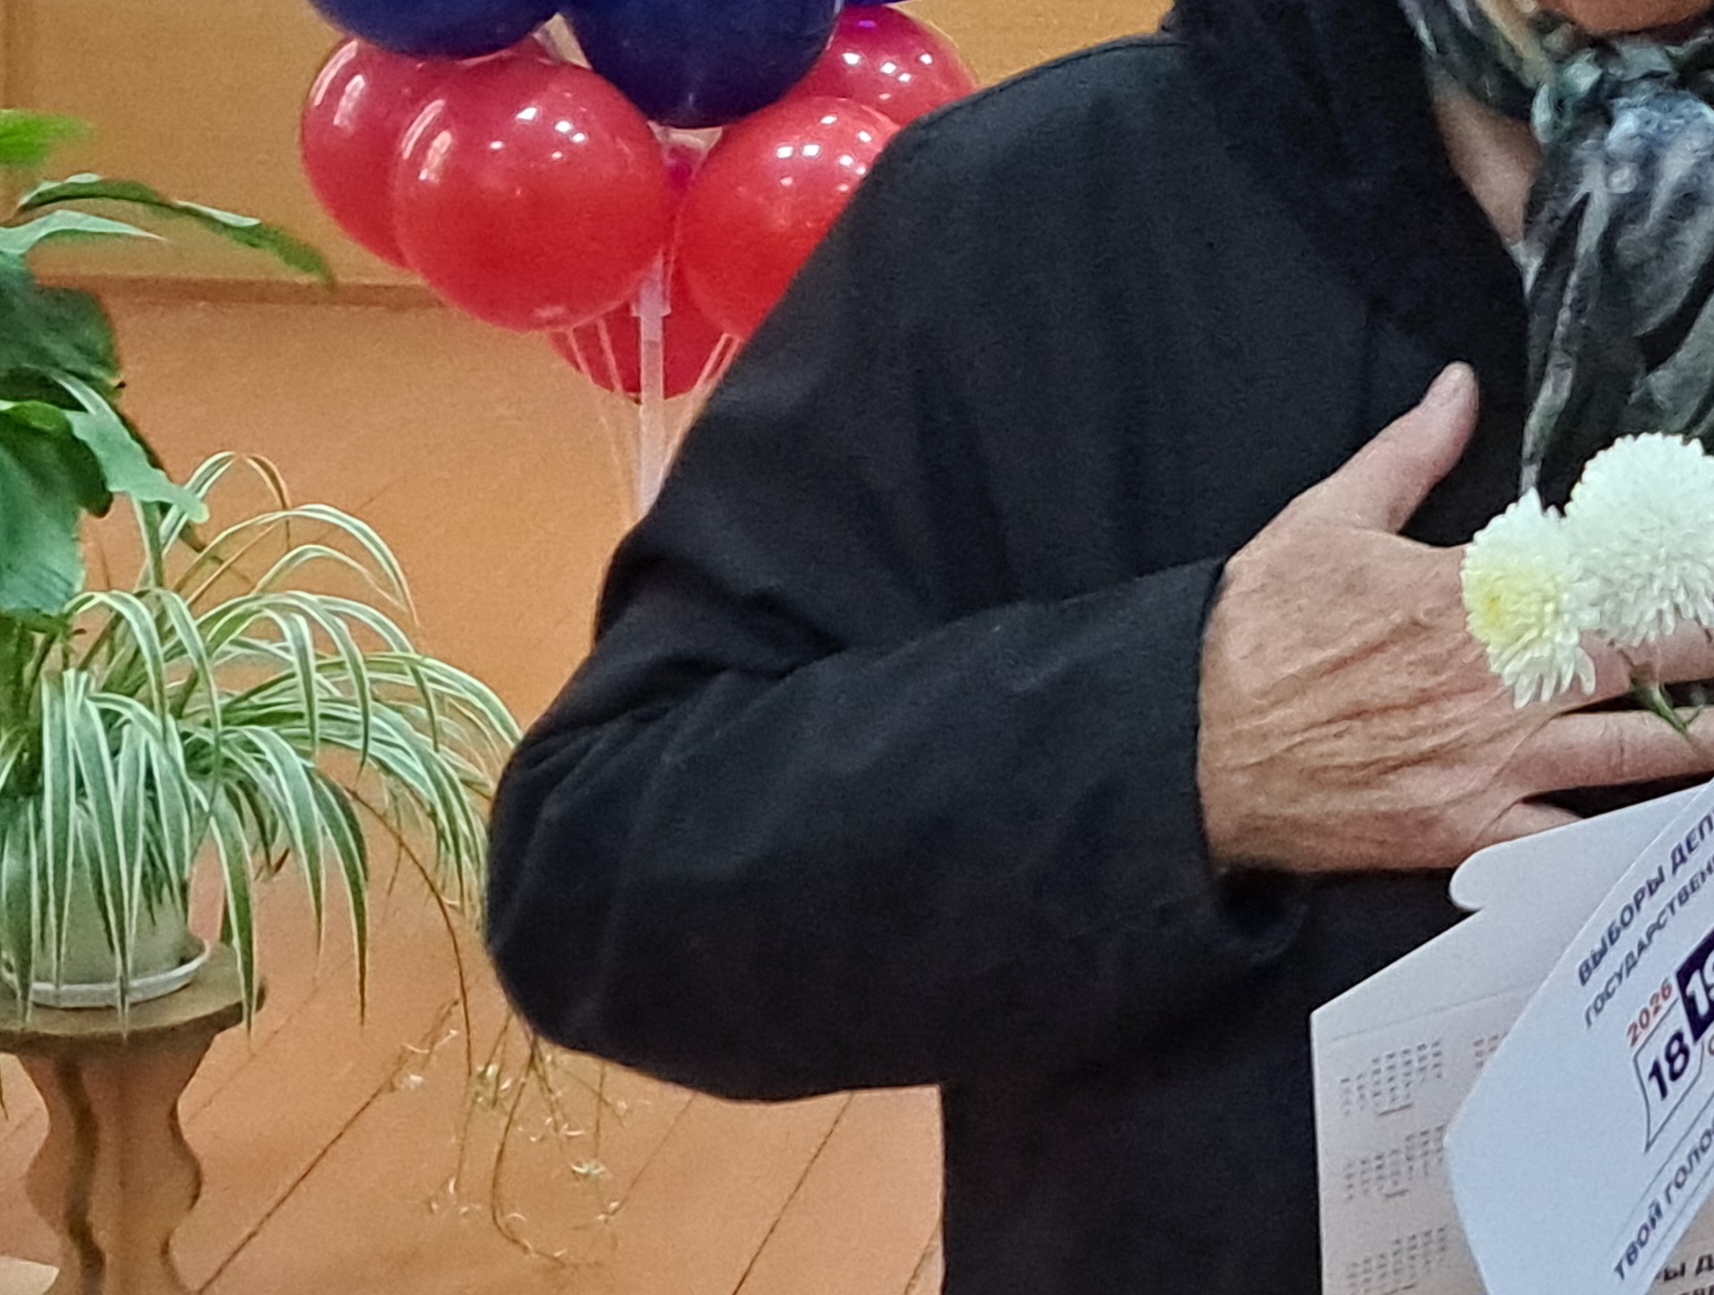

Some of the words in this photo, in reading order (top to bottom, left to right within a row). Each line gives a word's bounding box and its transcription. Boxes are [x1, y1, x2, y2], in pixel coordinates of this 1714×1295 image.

[1577, 865, 1665, 987] ВЫБОРЫ
[1627, 977, 1673, 1048] 2026
[1648, 1028, 1690, 1101] 18
[1613, 1193, 1664, 1281] ТВОЙ
